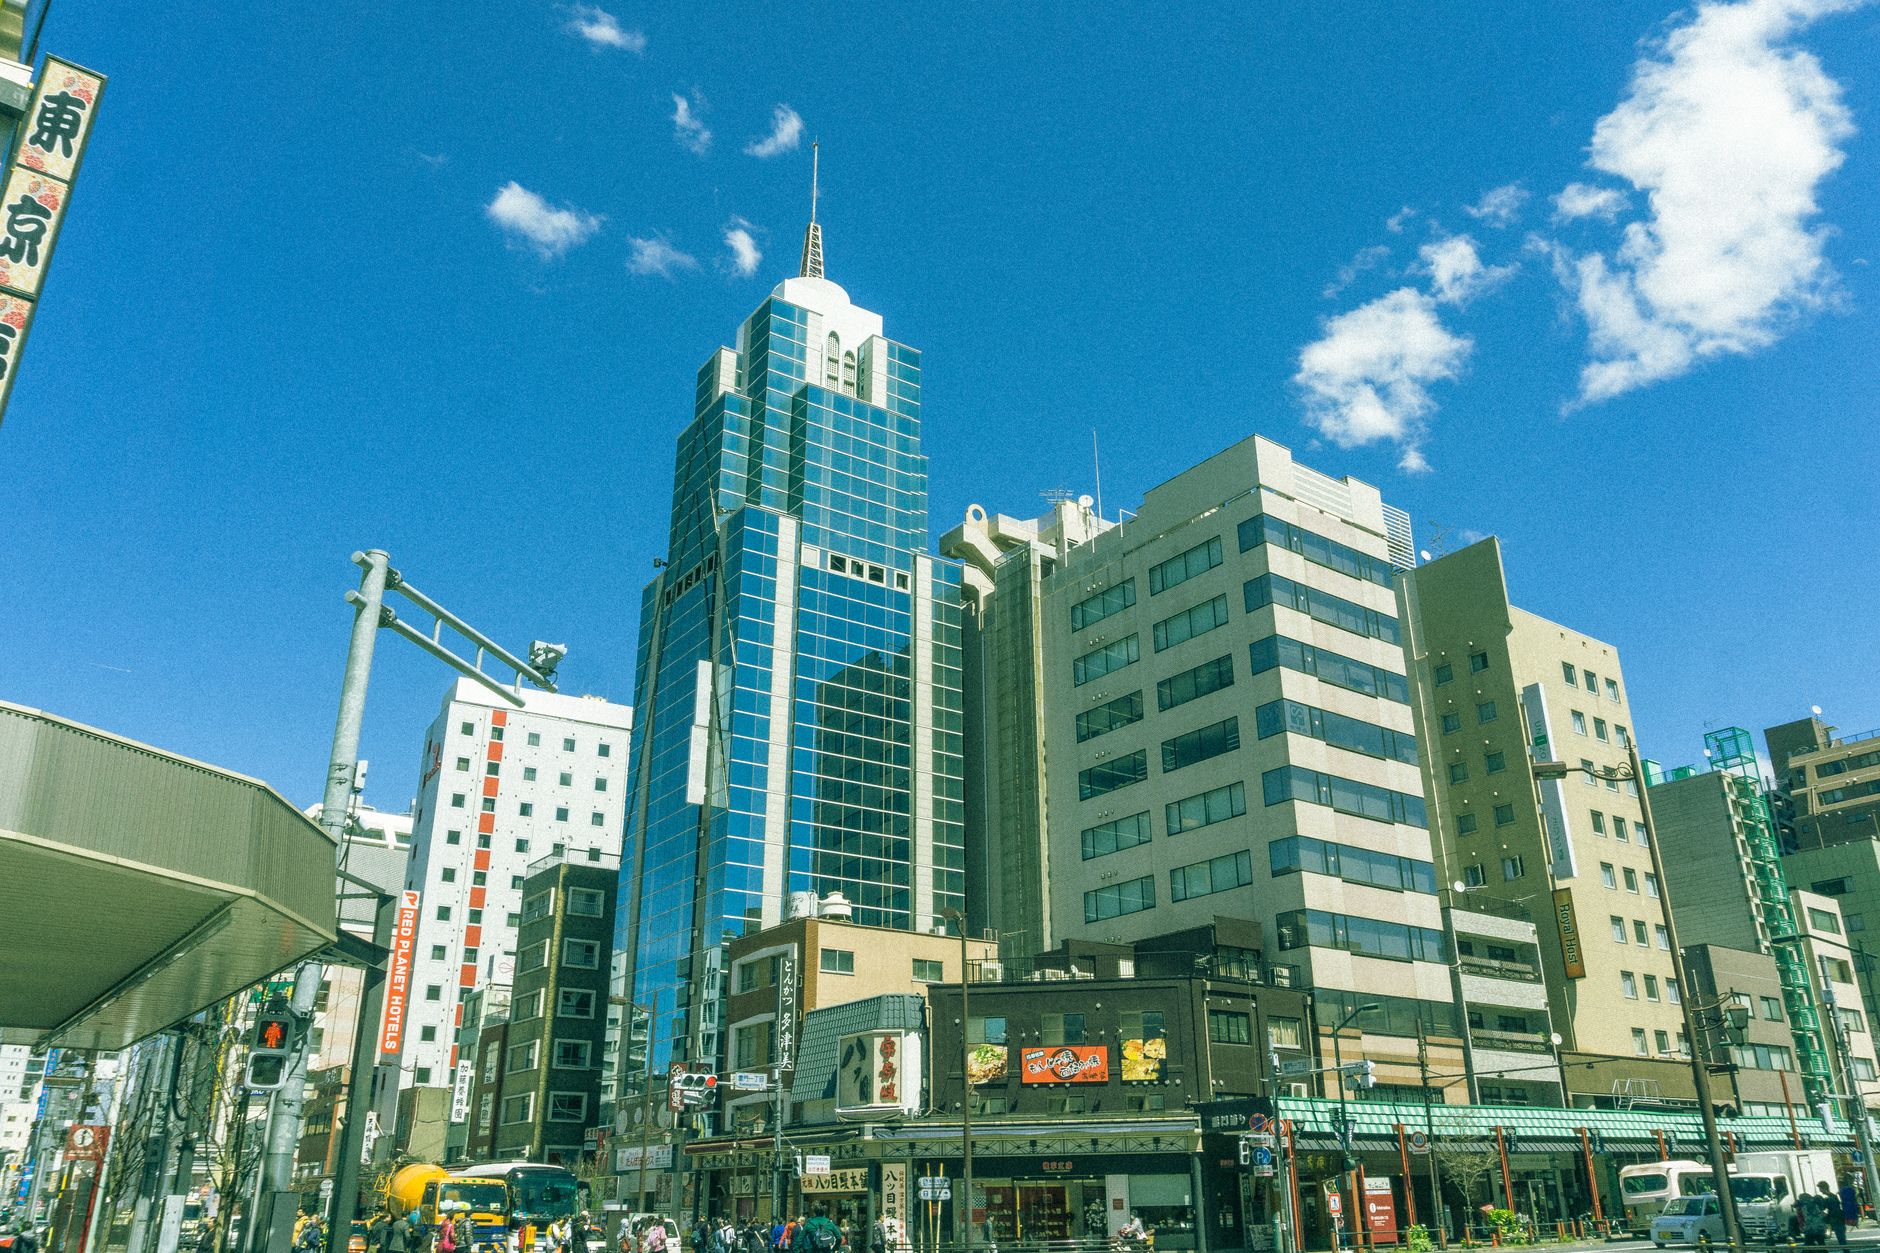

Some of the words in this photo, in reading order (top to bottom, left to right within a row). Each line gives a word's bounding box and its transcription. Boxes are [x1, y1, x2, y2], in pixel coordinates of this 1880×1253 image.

[400, 909, 415, 936] RED
[1560, 903, 1575, 934] Royal
[393, 939, 411, 993] PLANET
[1566, 938, 1579, 965] Host
[781, 960, 793, 1006] とんかつ
[384, 996, 403, 1049] HOTELS
[780, 1012, 793, 1069] 多津美
[1257, 1151, 1264, 1164] P
